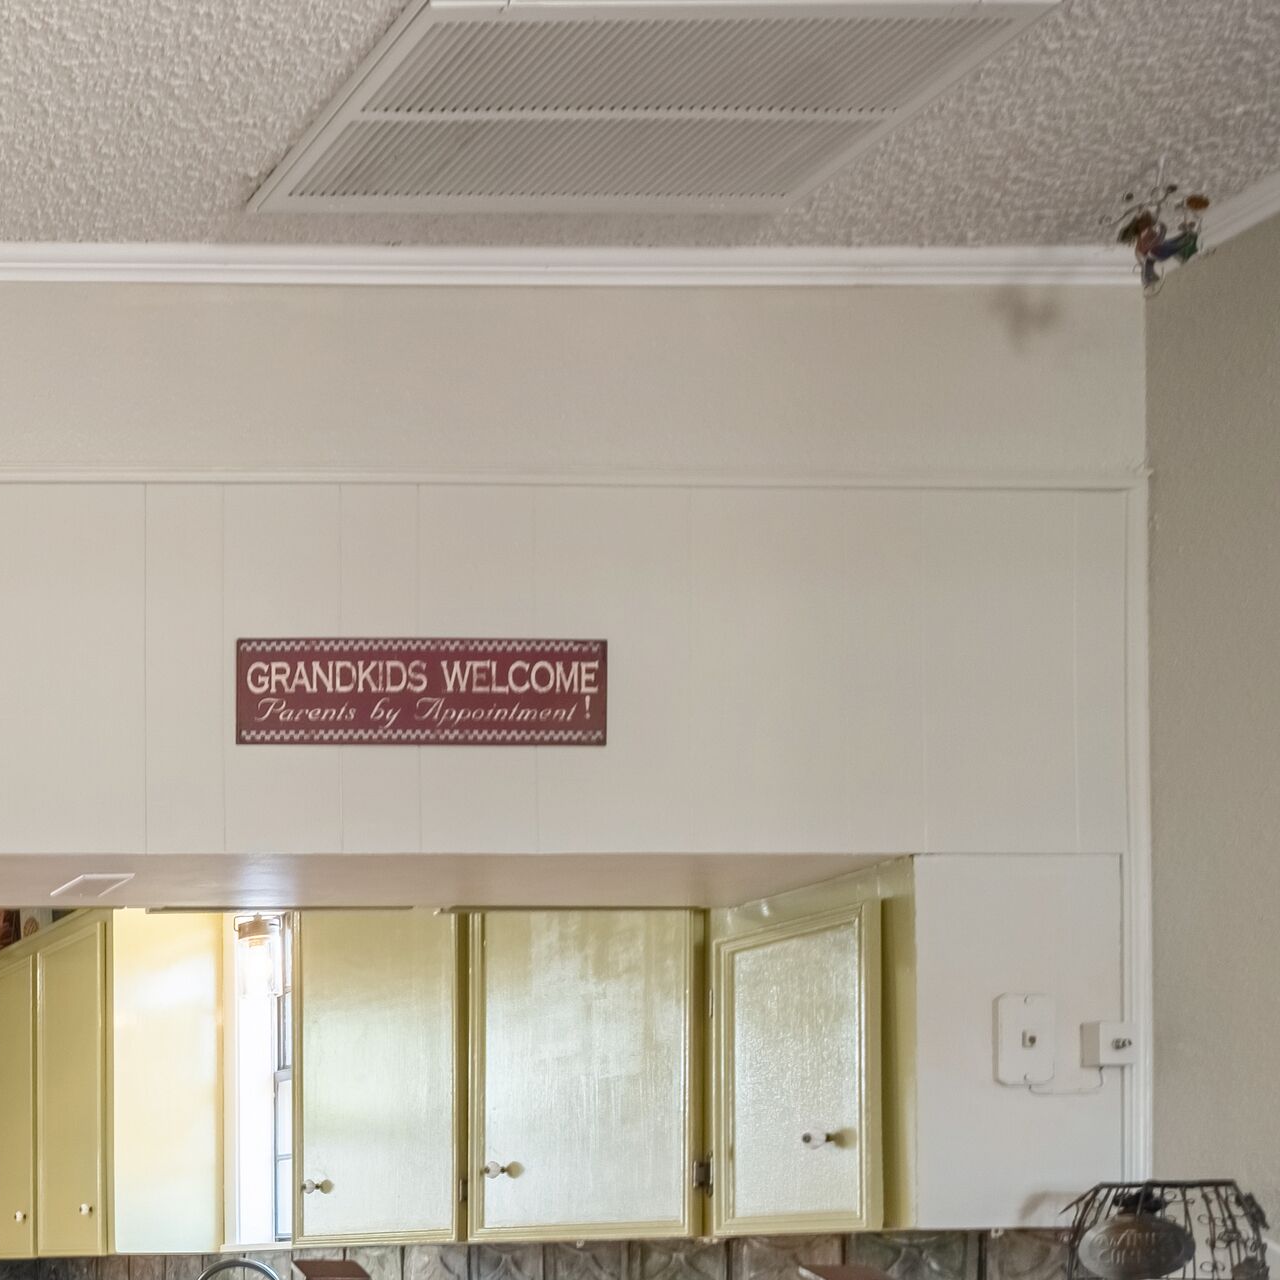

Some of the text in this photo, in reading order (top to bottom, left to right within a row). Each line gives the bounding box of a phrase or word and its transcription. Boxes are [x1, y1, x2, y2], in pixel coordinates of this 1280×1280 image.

[246, 660, 599, 694] GRANDKIDS WELCOME
[254, 697, 357, 722] Parents
[371, 697, 401, 728] by
